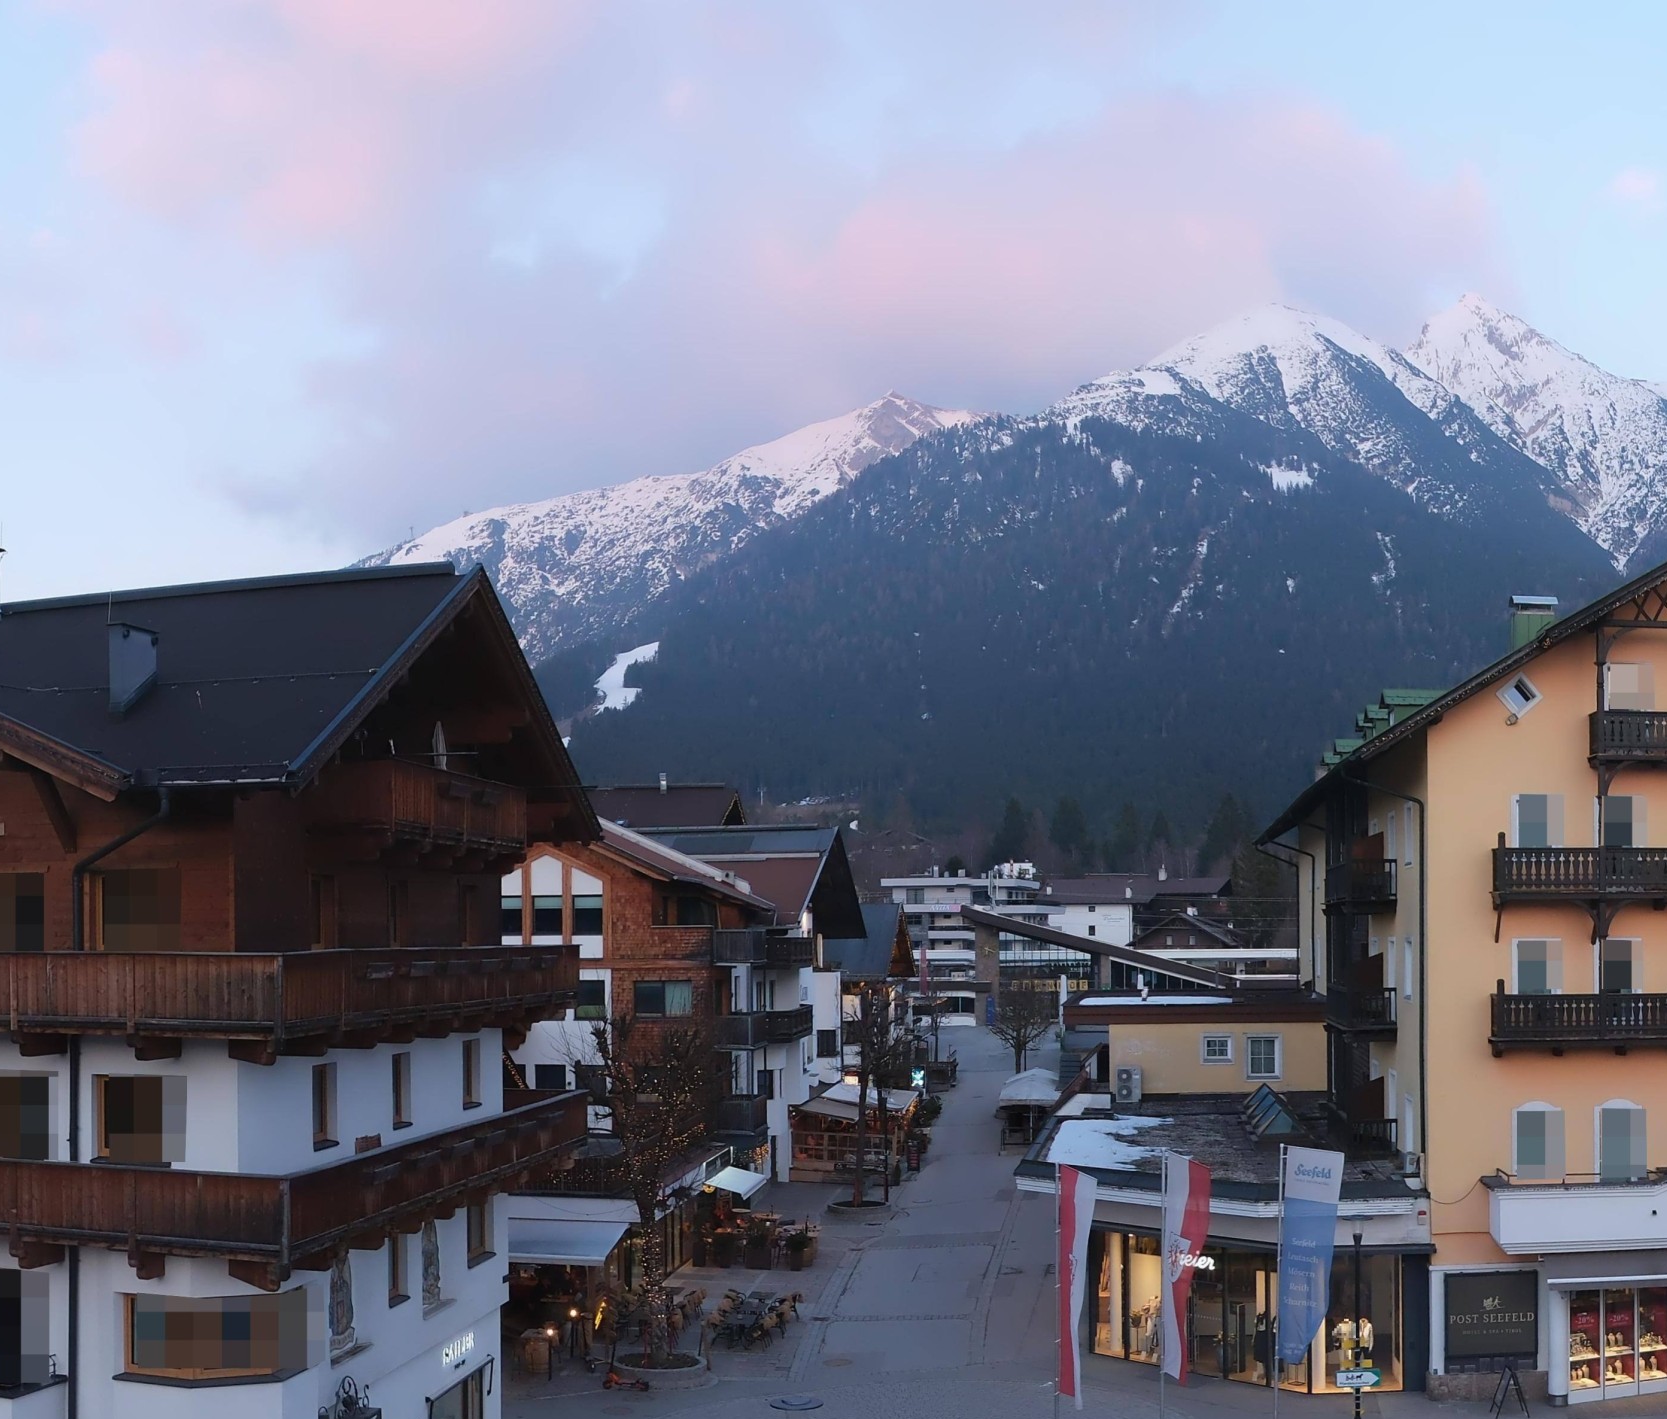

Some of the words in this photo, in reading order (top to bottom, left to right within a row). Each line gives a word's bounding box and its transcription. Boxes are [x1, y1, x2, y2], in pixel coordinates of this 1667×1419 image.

[1294, 1163, 1332, 1179] Seefeld
[1292, 1237, 1316, 1249] Seefeld
[1450, 1314, 1479, 1324] POST
[1483, 1312, 1535, 1323] SEEFELD
